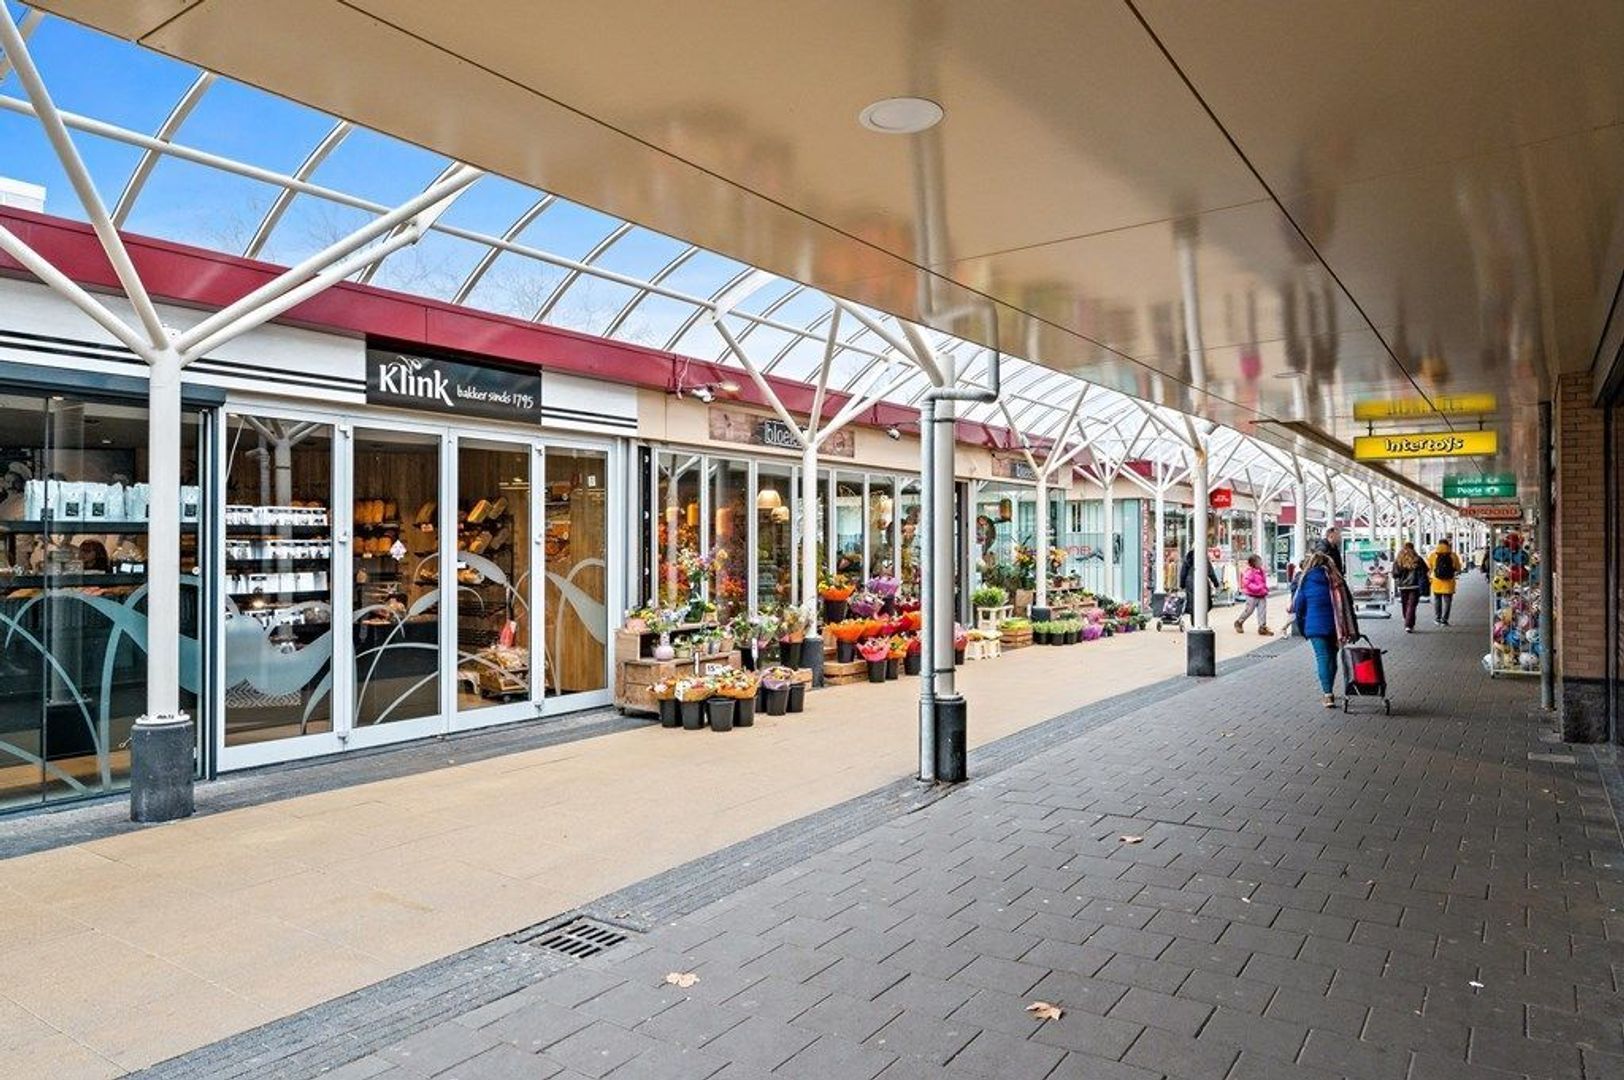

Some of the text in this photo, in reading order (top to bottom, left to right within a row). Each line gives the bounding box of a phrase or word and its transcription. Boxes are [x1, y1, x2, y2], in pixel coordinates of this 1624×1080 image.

[379, 358, 454, 406] Klink
[457, 383, 534, 409] bakker sinds 1795
[1387, 437, 1464, 452] Intertoys
